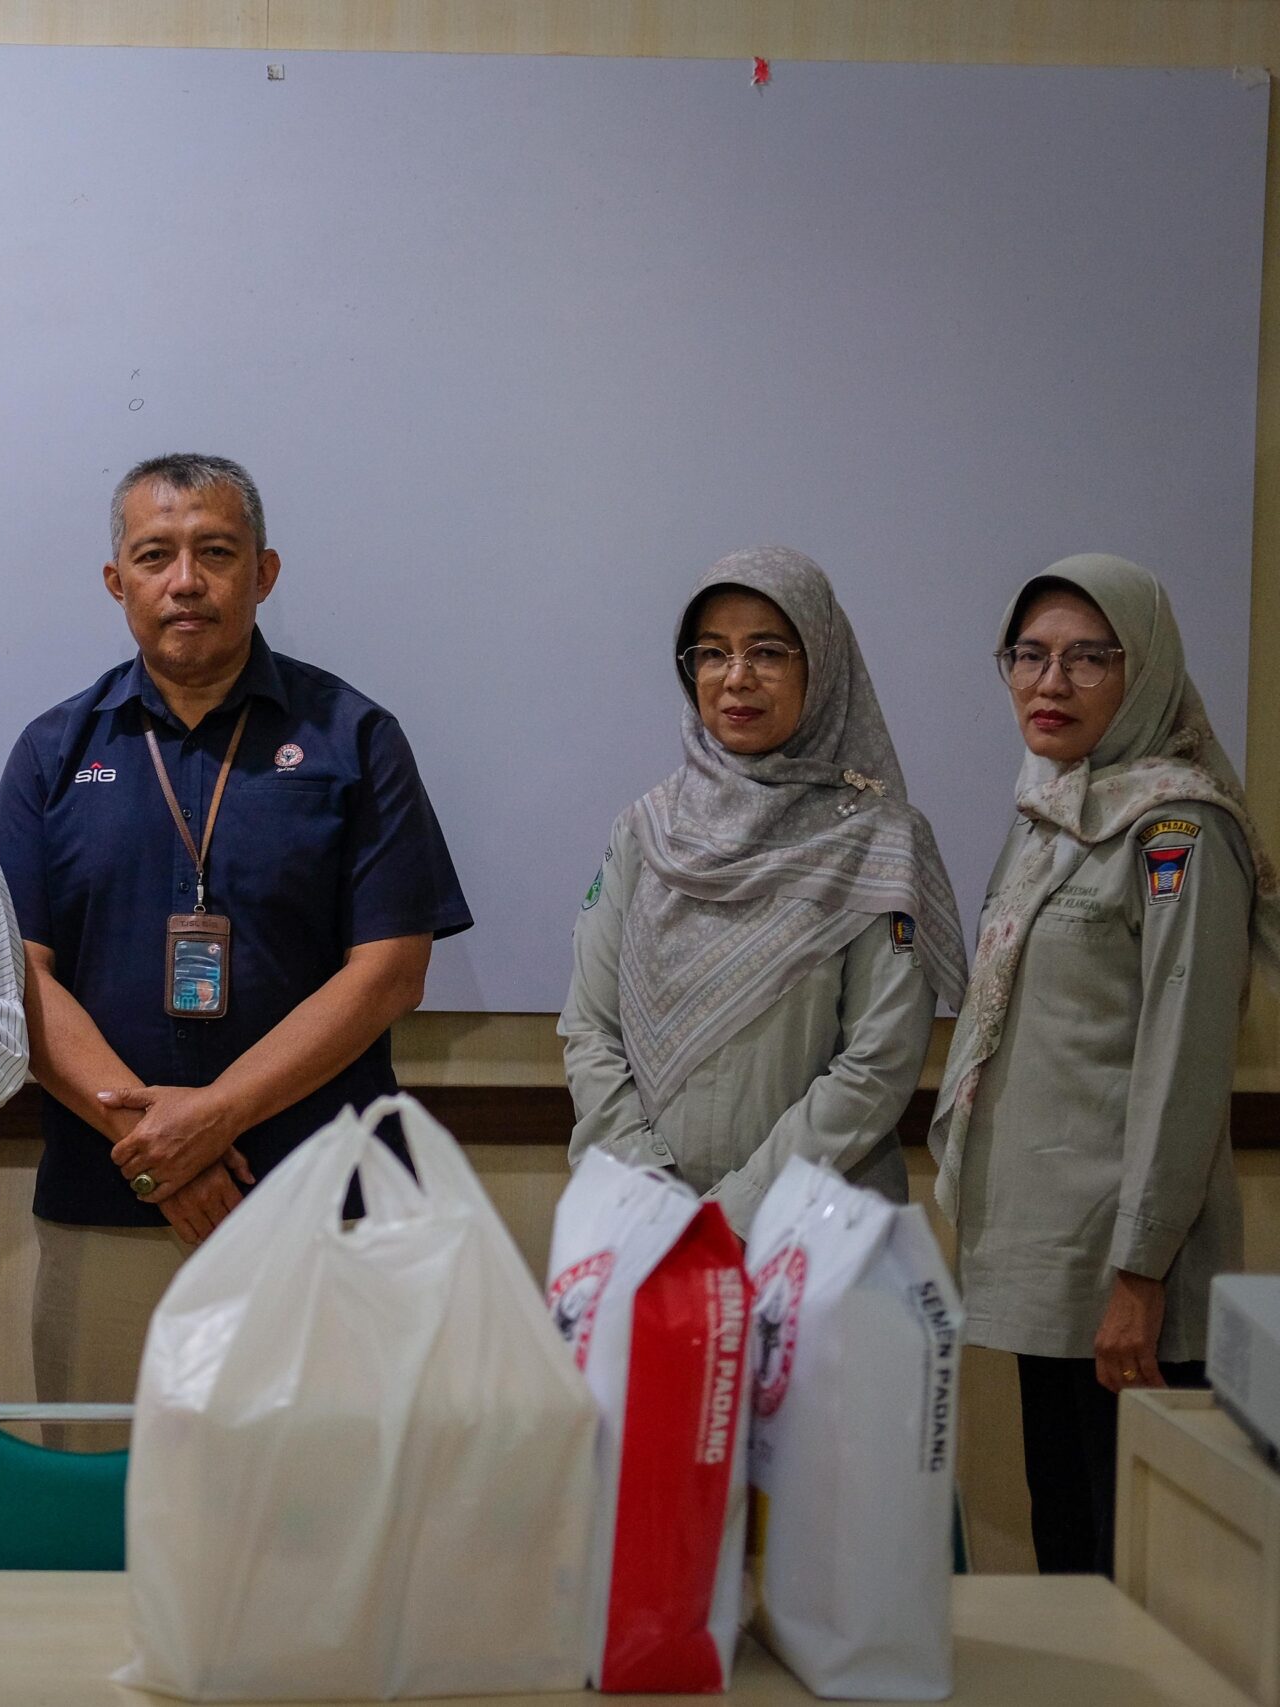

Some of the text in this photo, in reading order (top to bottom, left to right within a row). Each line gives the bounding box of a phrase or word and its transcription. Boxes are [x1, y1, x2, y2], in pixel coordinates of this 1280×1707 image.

[75, 768, 116, 783] SIG
[1161, 822, 1196, 835] PADANG
[717, 1267, 745, 1353] SEMEN
[704, 1359, 738, 1465] PADANG
[921, 1281, 957, 1473] SEMEN PADANG
